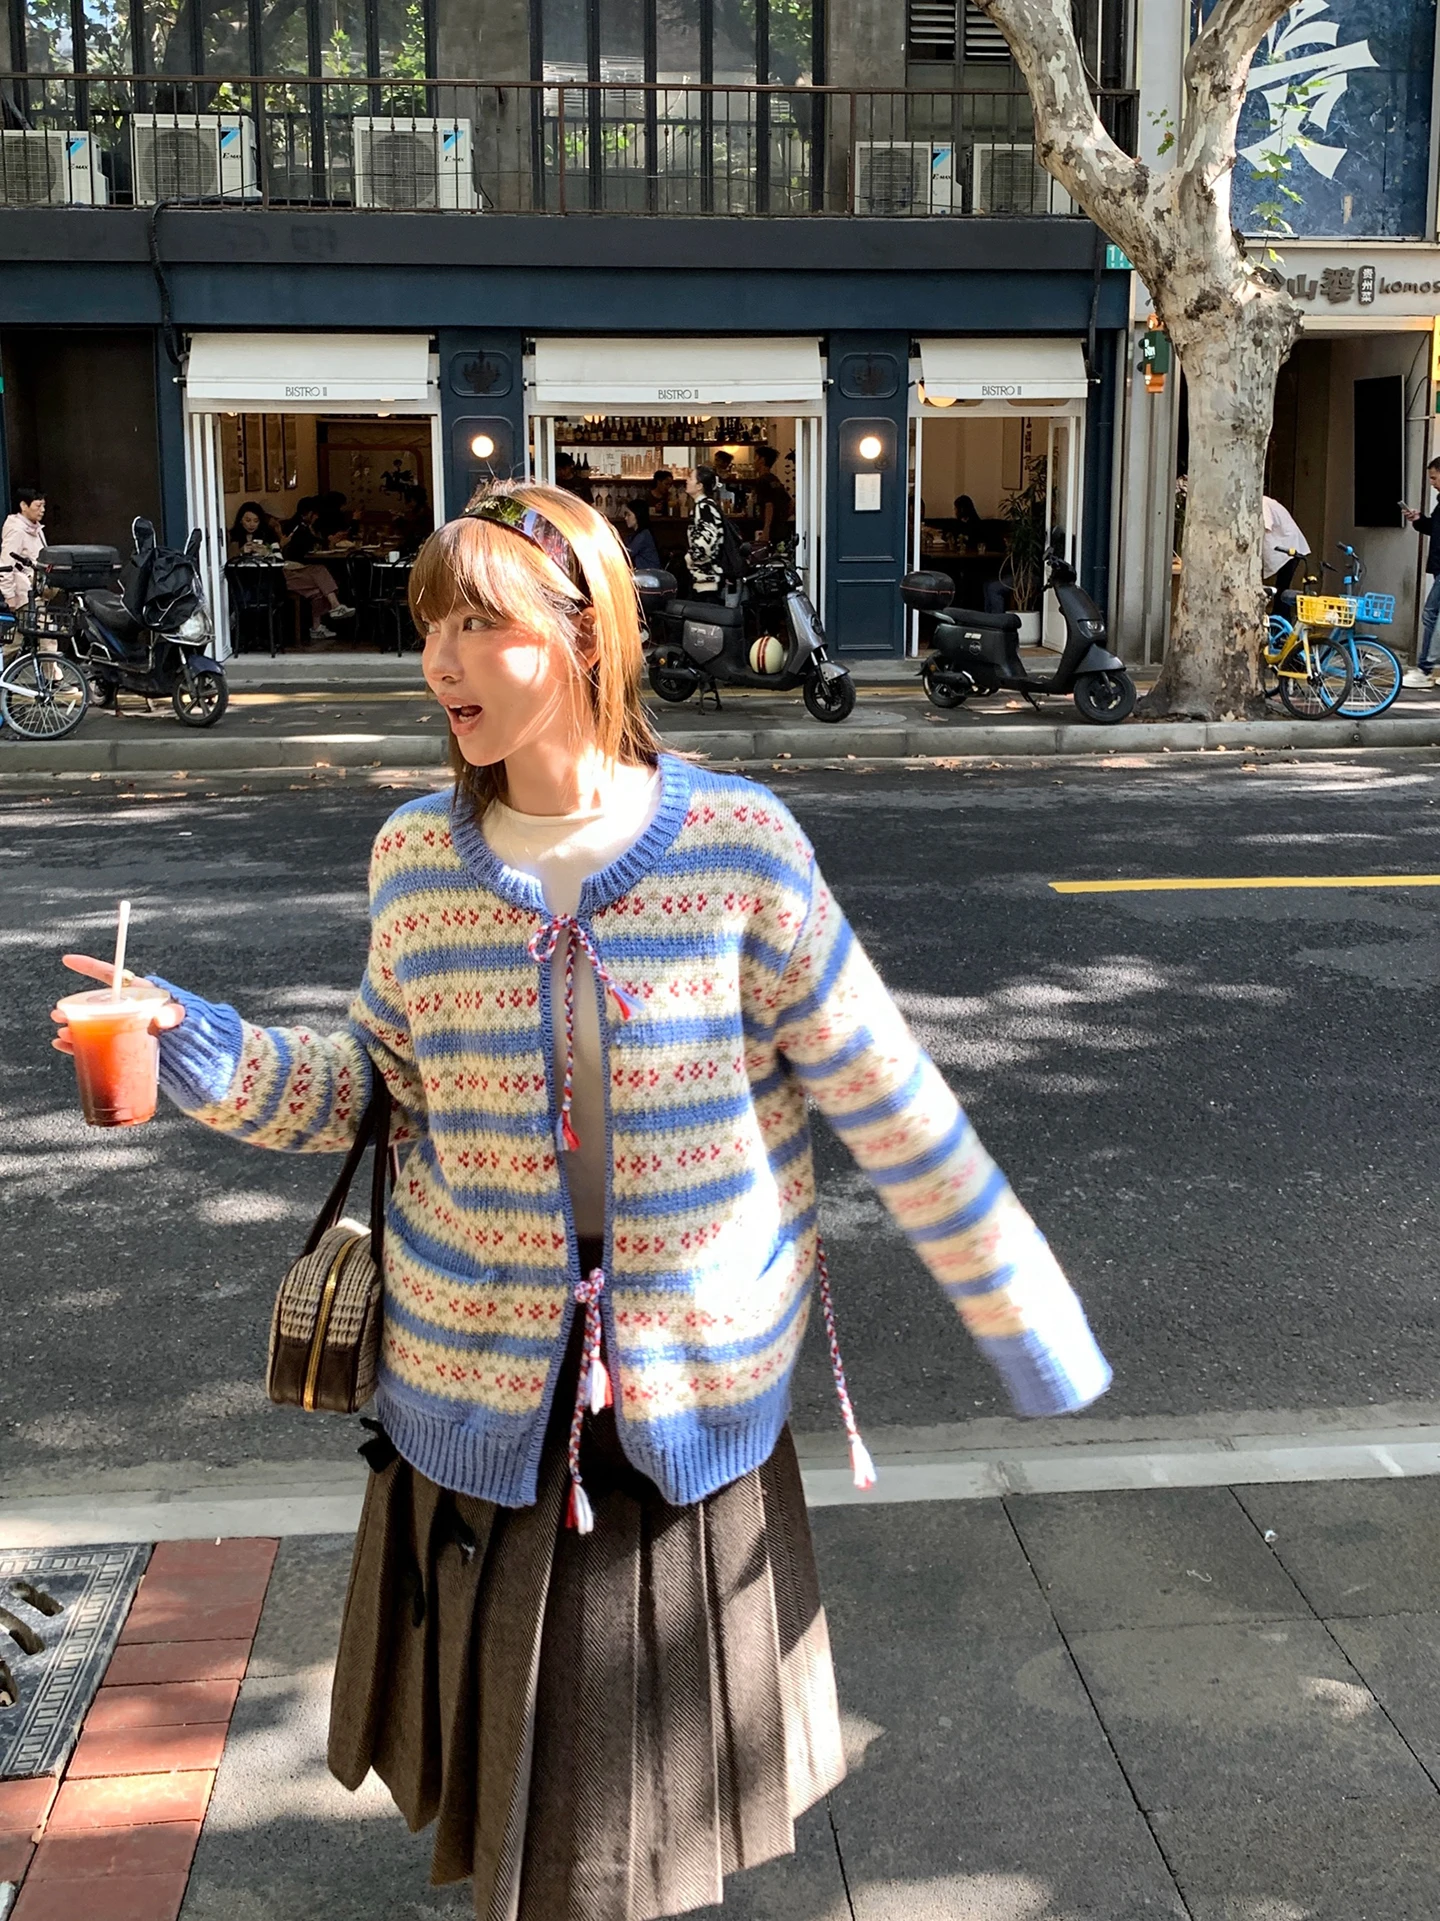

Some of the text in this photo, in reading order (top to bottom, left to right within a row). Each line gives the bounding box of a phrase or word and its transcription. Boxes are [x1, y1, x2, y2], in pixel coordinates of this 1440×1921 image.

[1361, 268, 1374, 302] 贵州菜
[285, 386, 321, 397] BISTRO
[658, 389, 692, 400] BISTRO
[981, 385, 1016, 396] BISTRO
